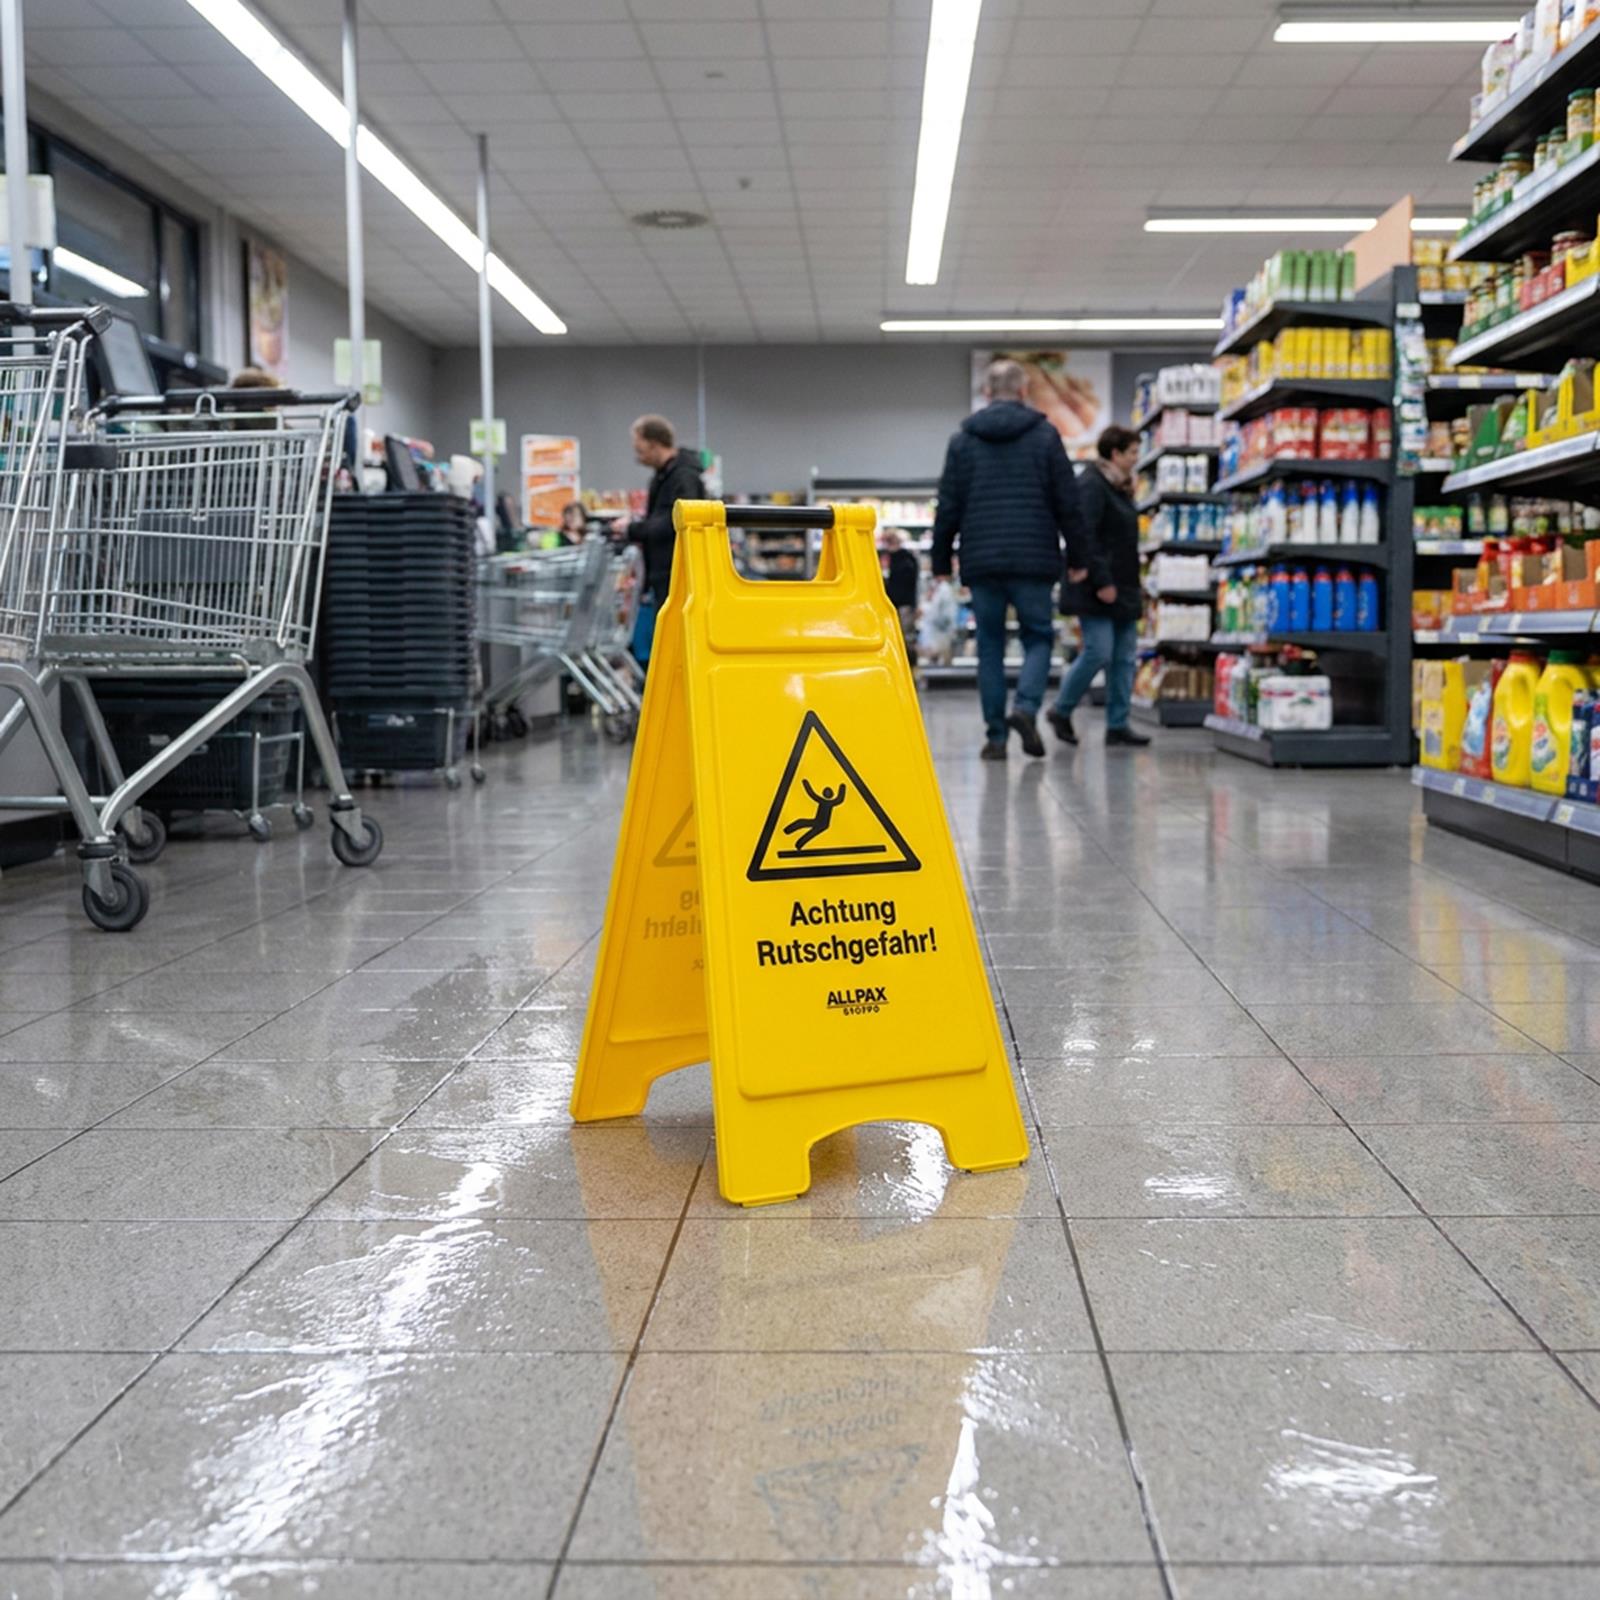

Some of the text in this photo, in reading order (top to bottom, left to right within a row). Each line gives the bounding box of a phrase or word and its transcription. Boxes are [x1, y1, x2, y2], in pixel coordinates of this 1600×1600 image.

[790, 898, 897, 926] Achtung
[756, 927, 937, 966] Rutschgefahr!
[827, 986, 888, 1005] ALLPAX
